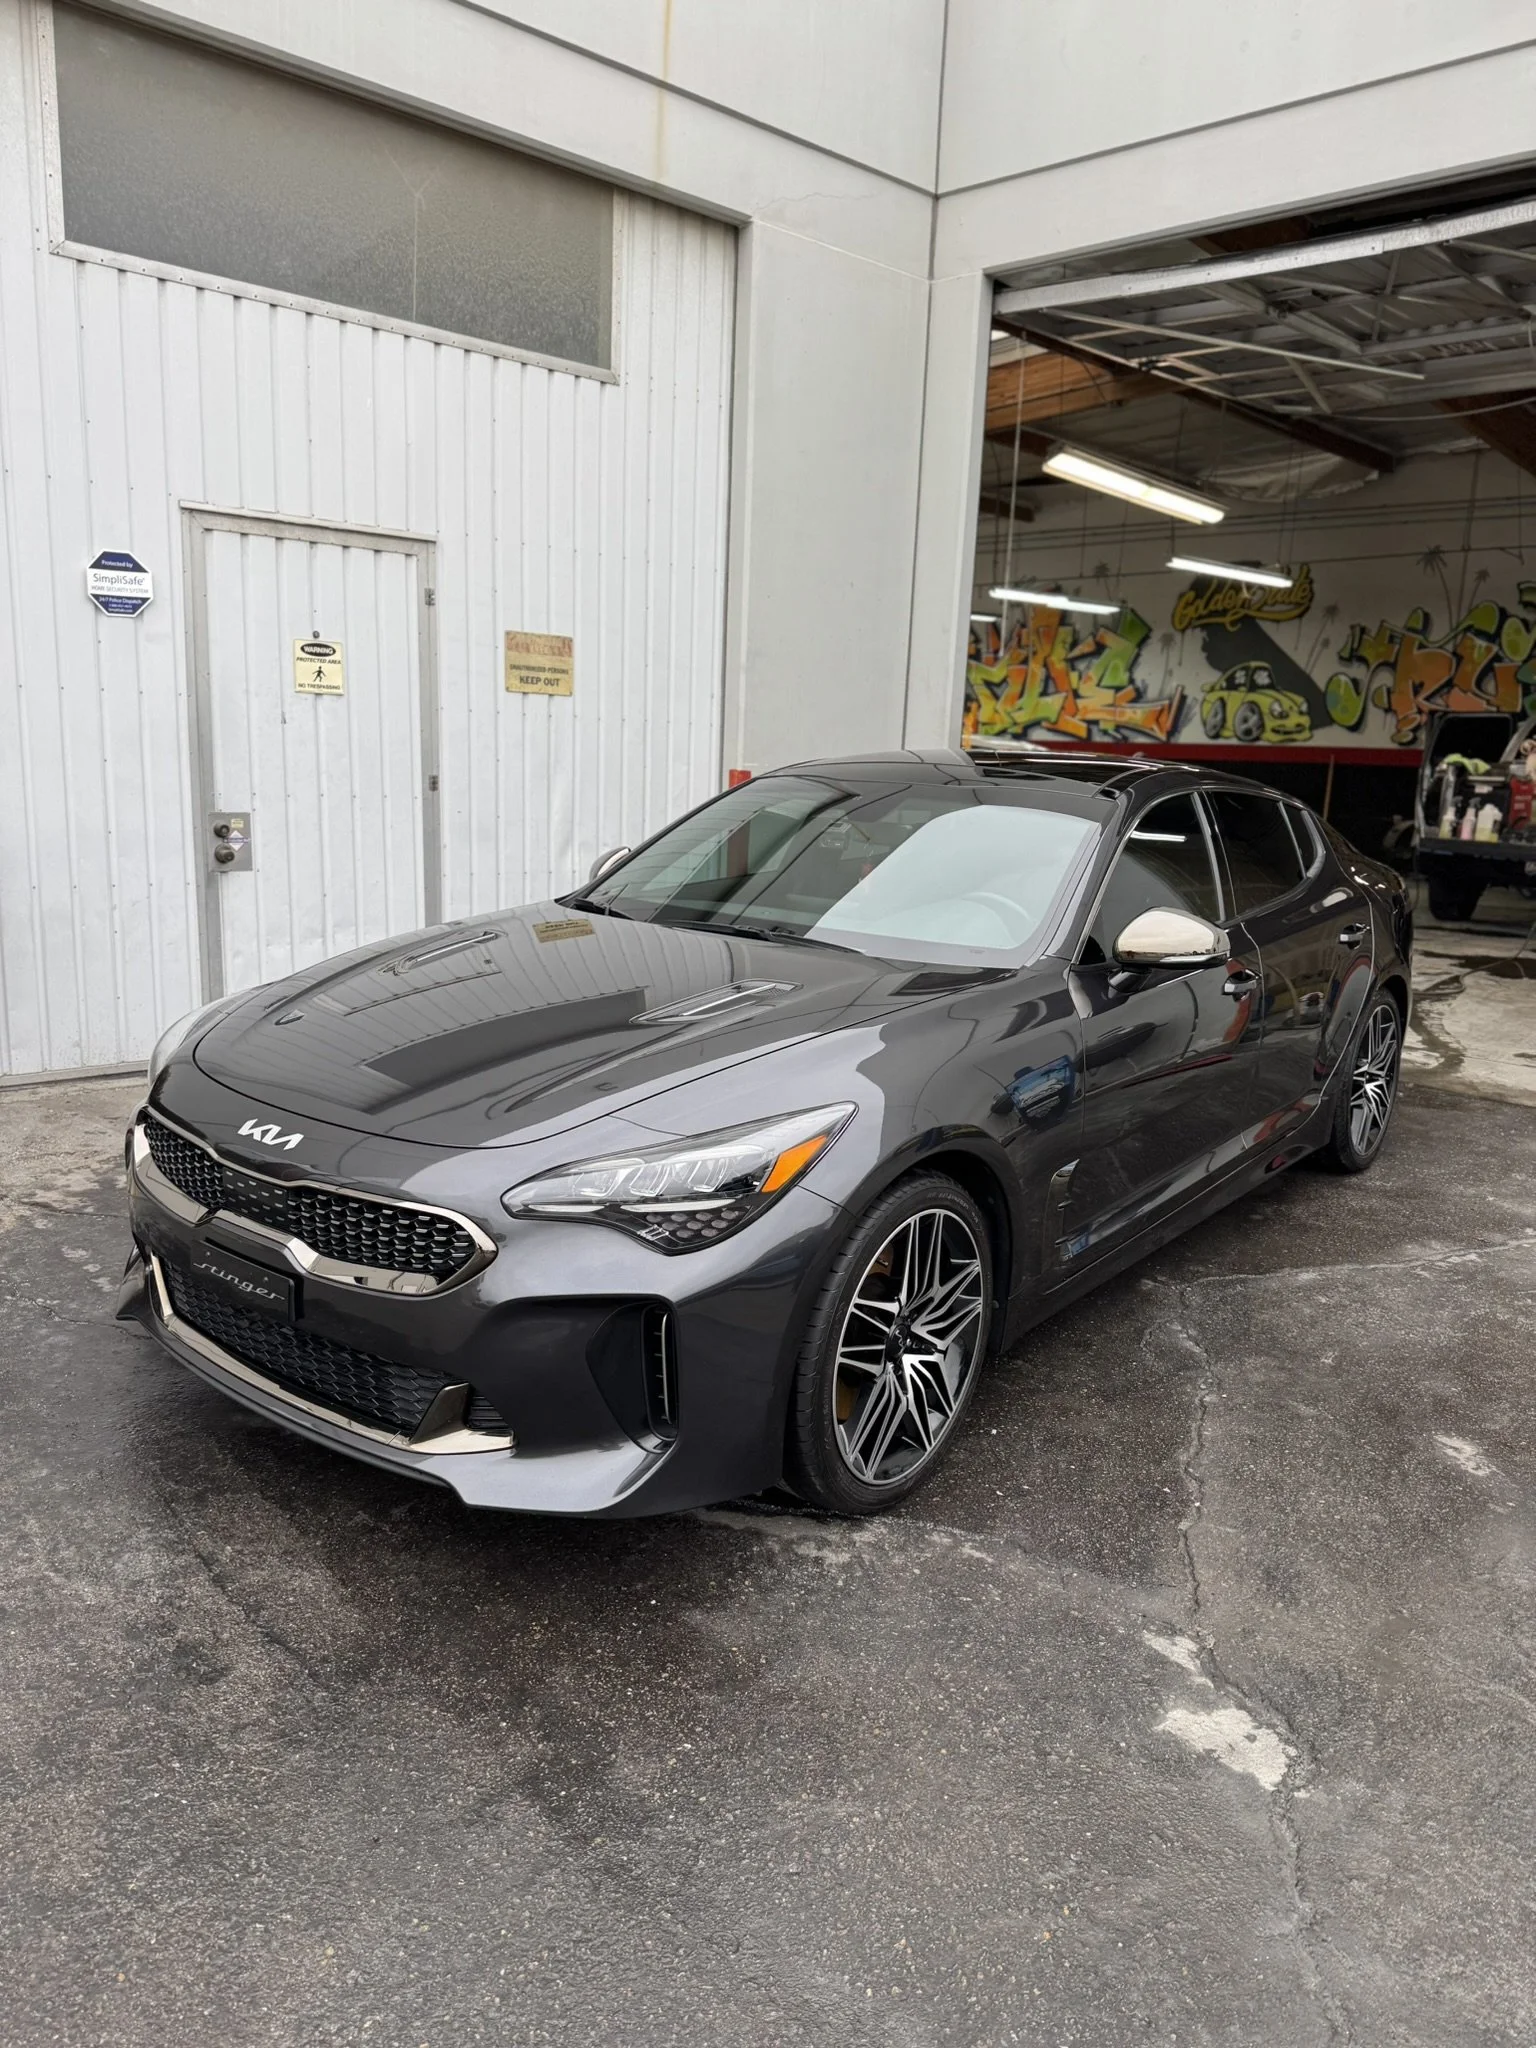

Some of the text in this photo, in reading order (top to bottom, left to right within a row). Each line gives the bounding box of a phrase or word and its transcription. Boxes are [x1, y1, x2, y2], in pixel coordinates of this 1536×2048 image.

[101, 559, 134, 569] Protected by
[93, 572, 144, 586] SimpliSafe
[303, 645, 334, 655] WARNING
[296, 656, 327, 664] PROTECTED
[519, 675, 561, 687] KEEP OUT
